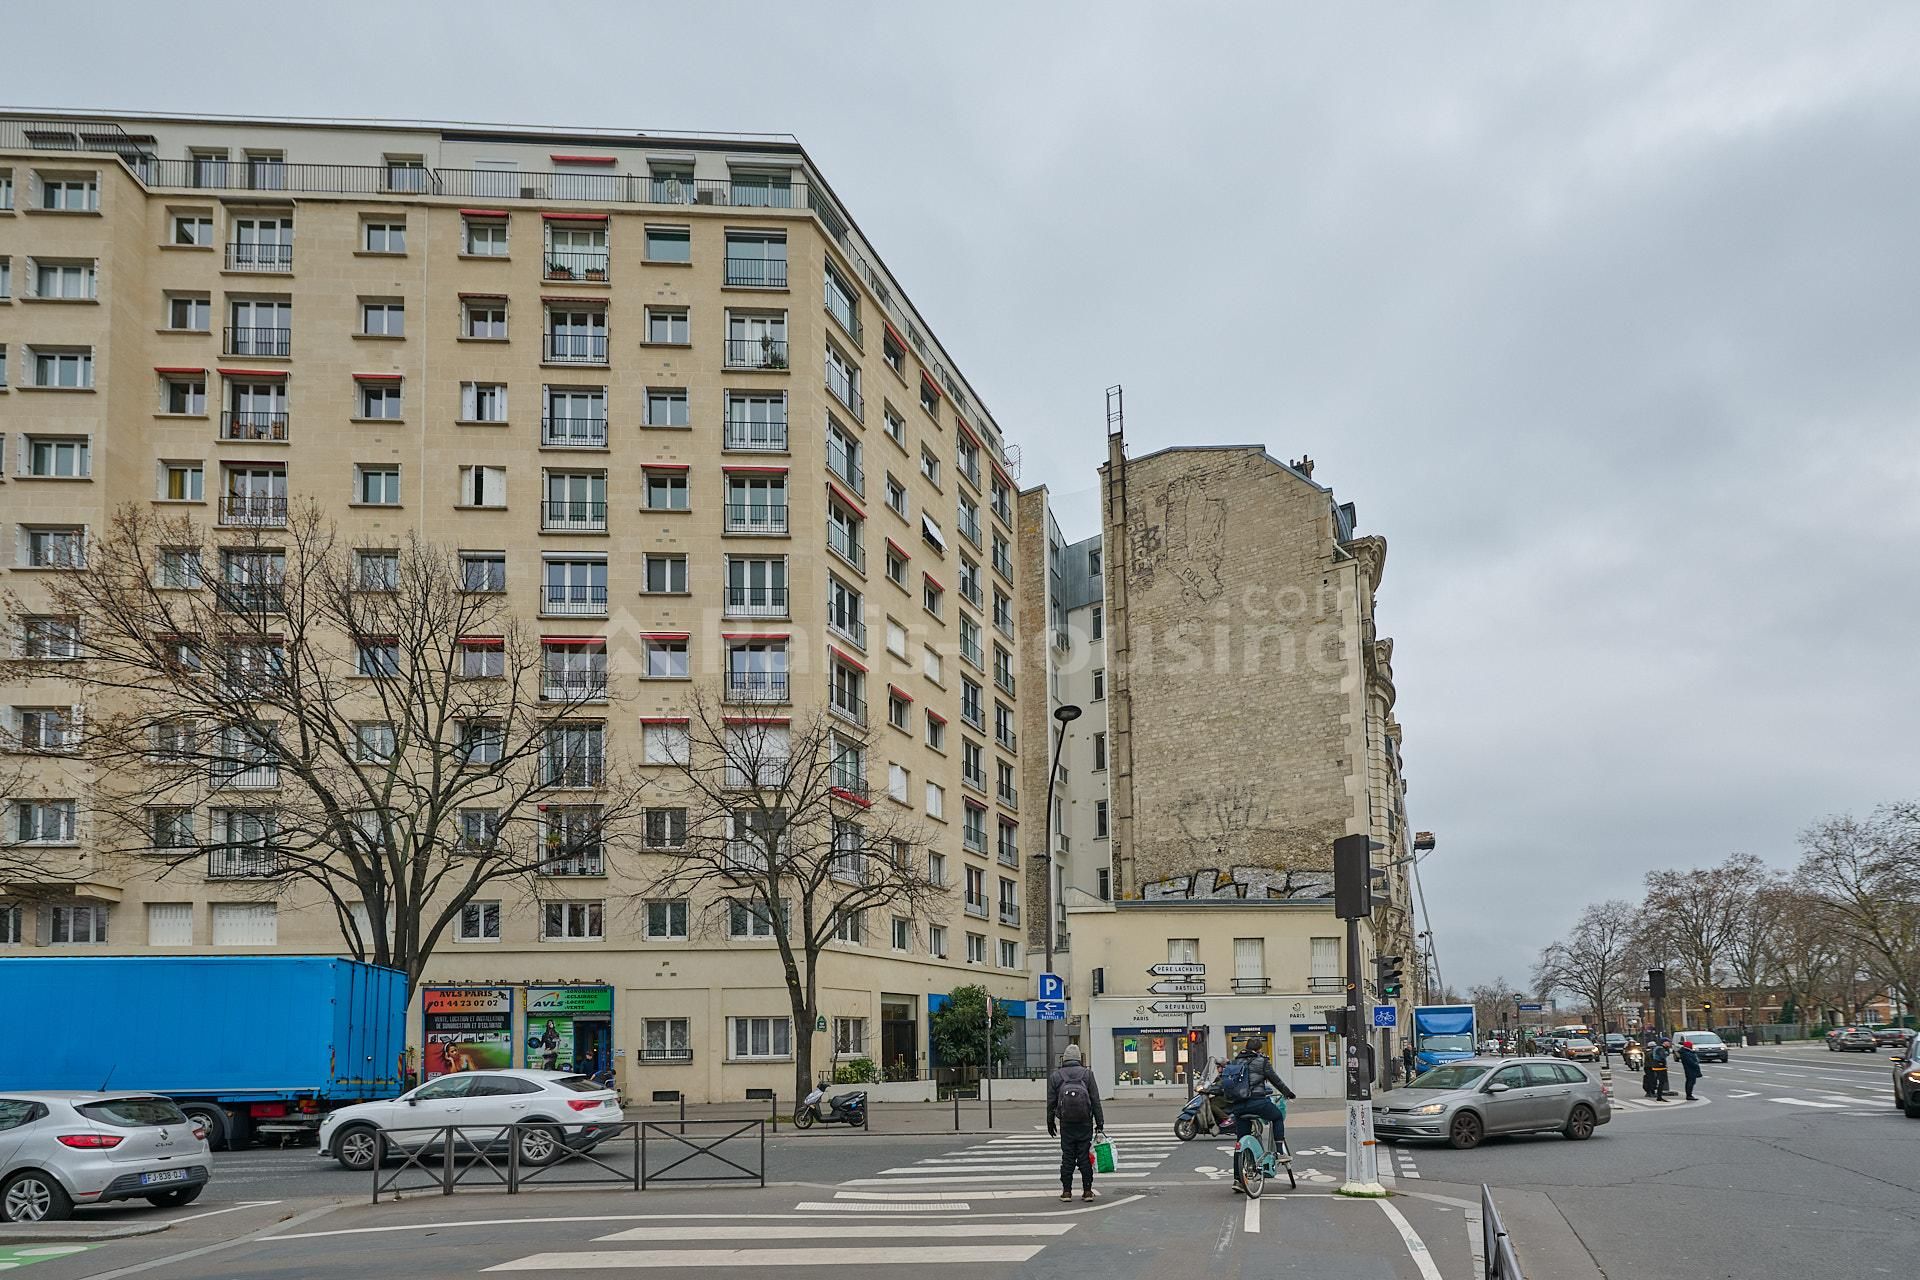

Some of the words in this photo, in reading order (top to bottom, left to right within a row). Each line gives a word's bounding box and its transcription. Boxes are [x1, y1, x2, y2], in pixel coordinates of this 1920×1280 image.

[1046, 978, 1057, 996] P
[439, 990, 462, 998] AVLS
[465, 990, 493, 998] PARIS
[460, 999, 472, 1007] 73
[473, 999, 485, 1007] 07
[487, 999, 498, 1007] 07
[533, 1000, 564, 1008] AVLS
